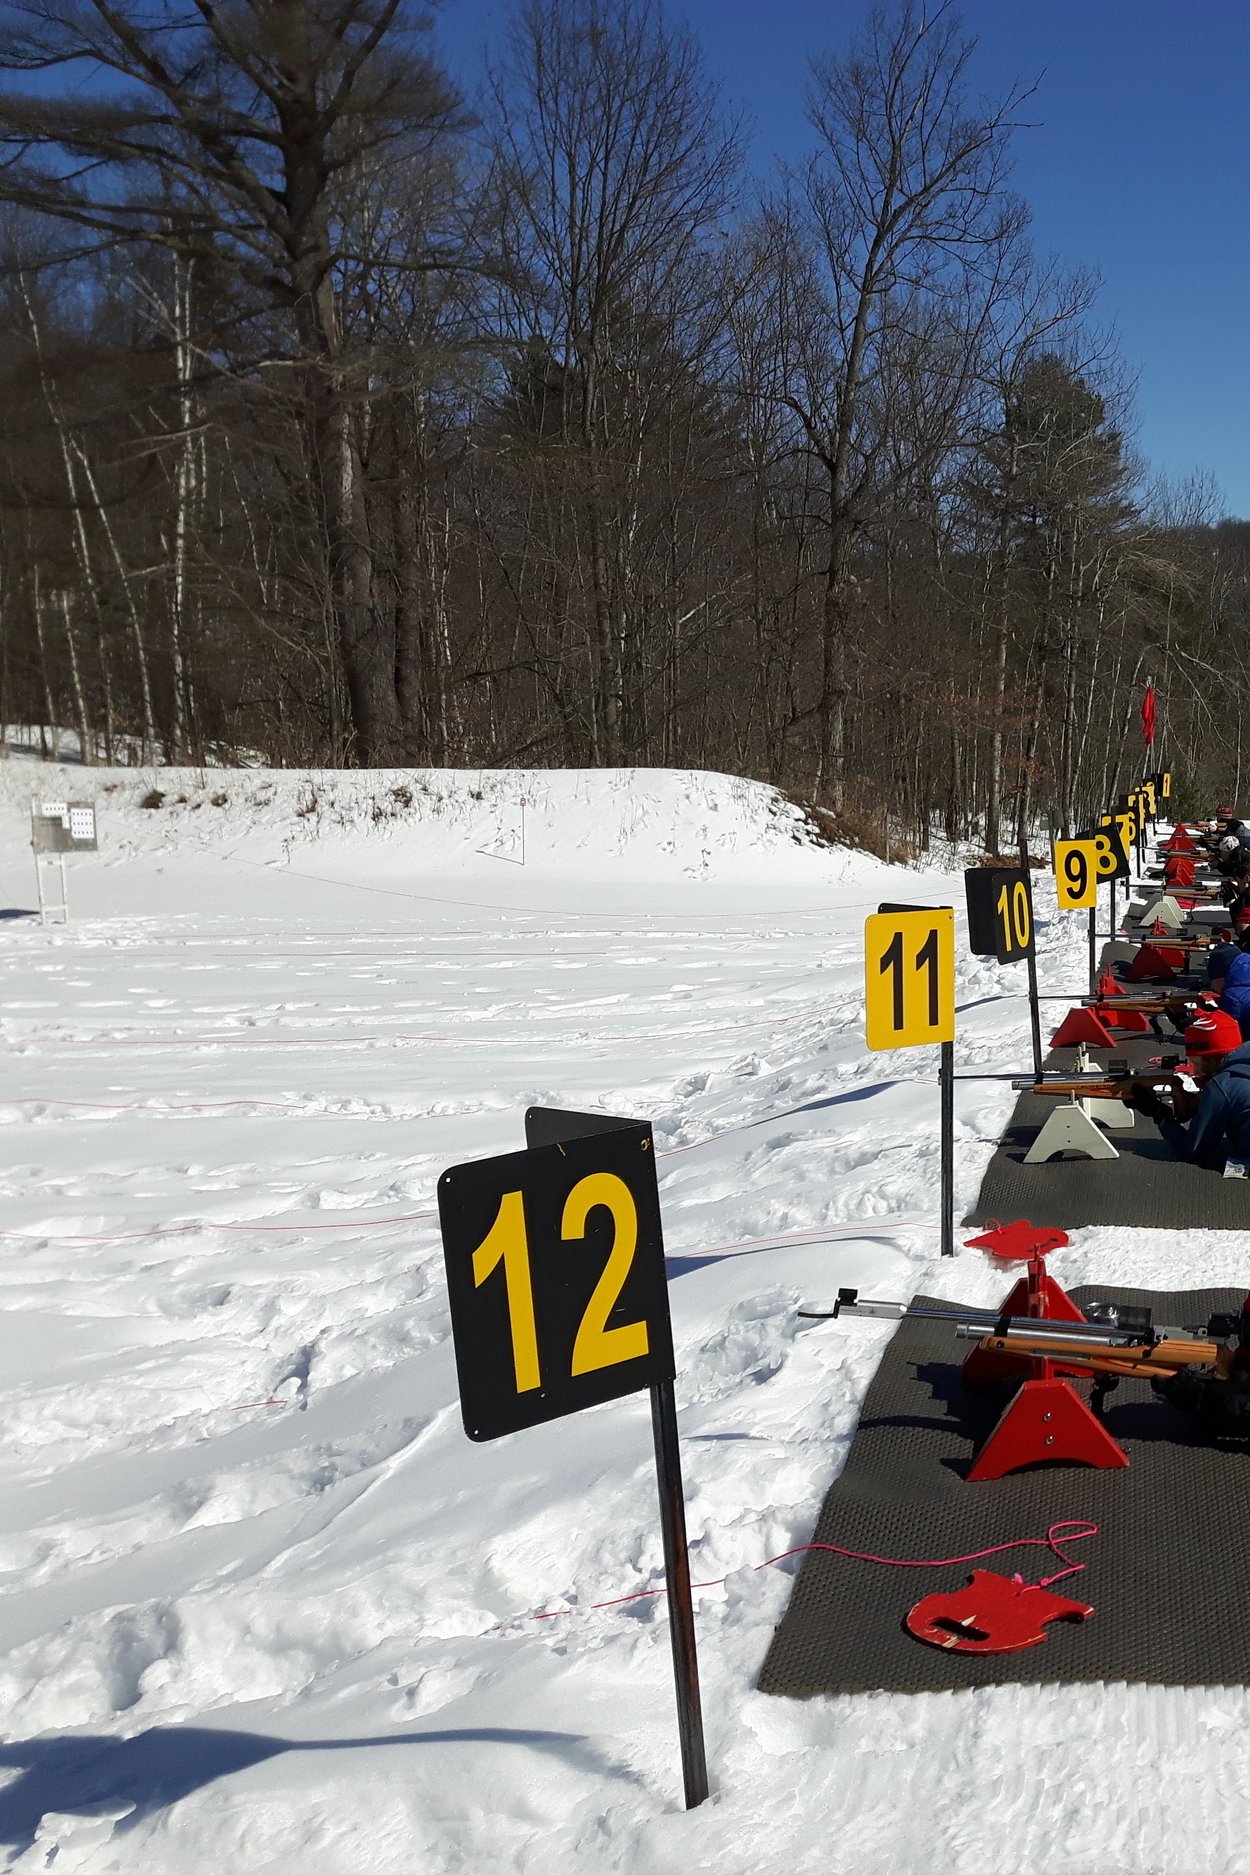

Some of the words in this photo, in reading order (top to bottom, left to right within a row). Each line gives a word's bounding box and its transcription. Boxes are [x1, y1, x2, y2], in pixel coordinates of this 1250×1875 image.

[1064, 849, 1088, 901] 9
[1095, 834, 1118, 875] 8
[997, 880, 1031, 952] 10
[879, 929, 940, 1031] 11
[471, 1172, 650, 1394] 12
